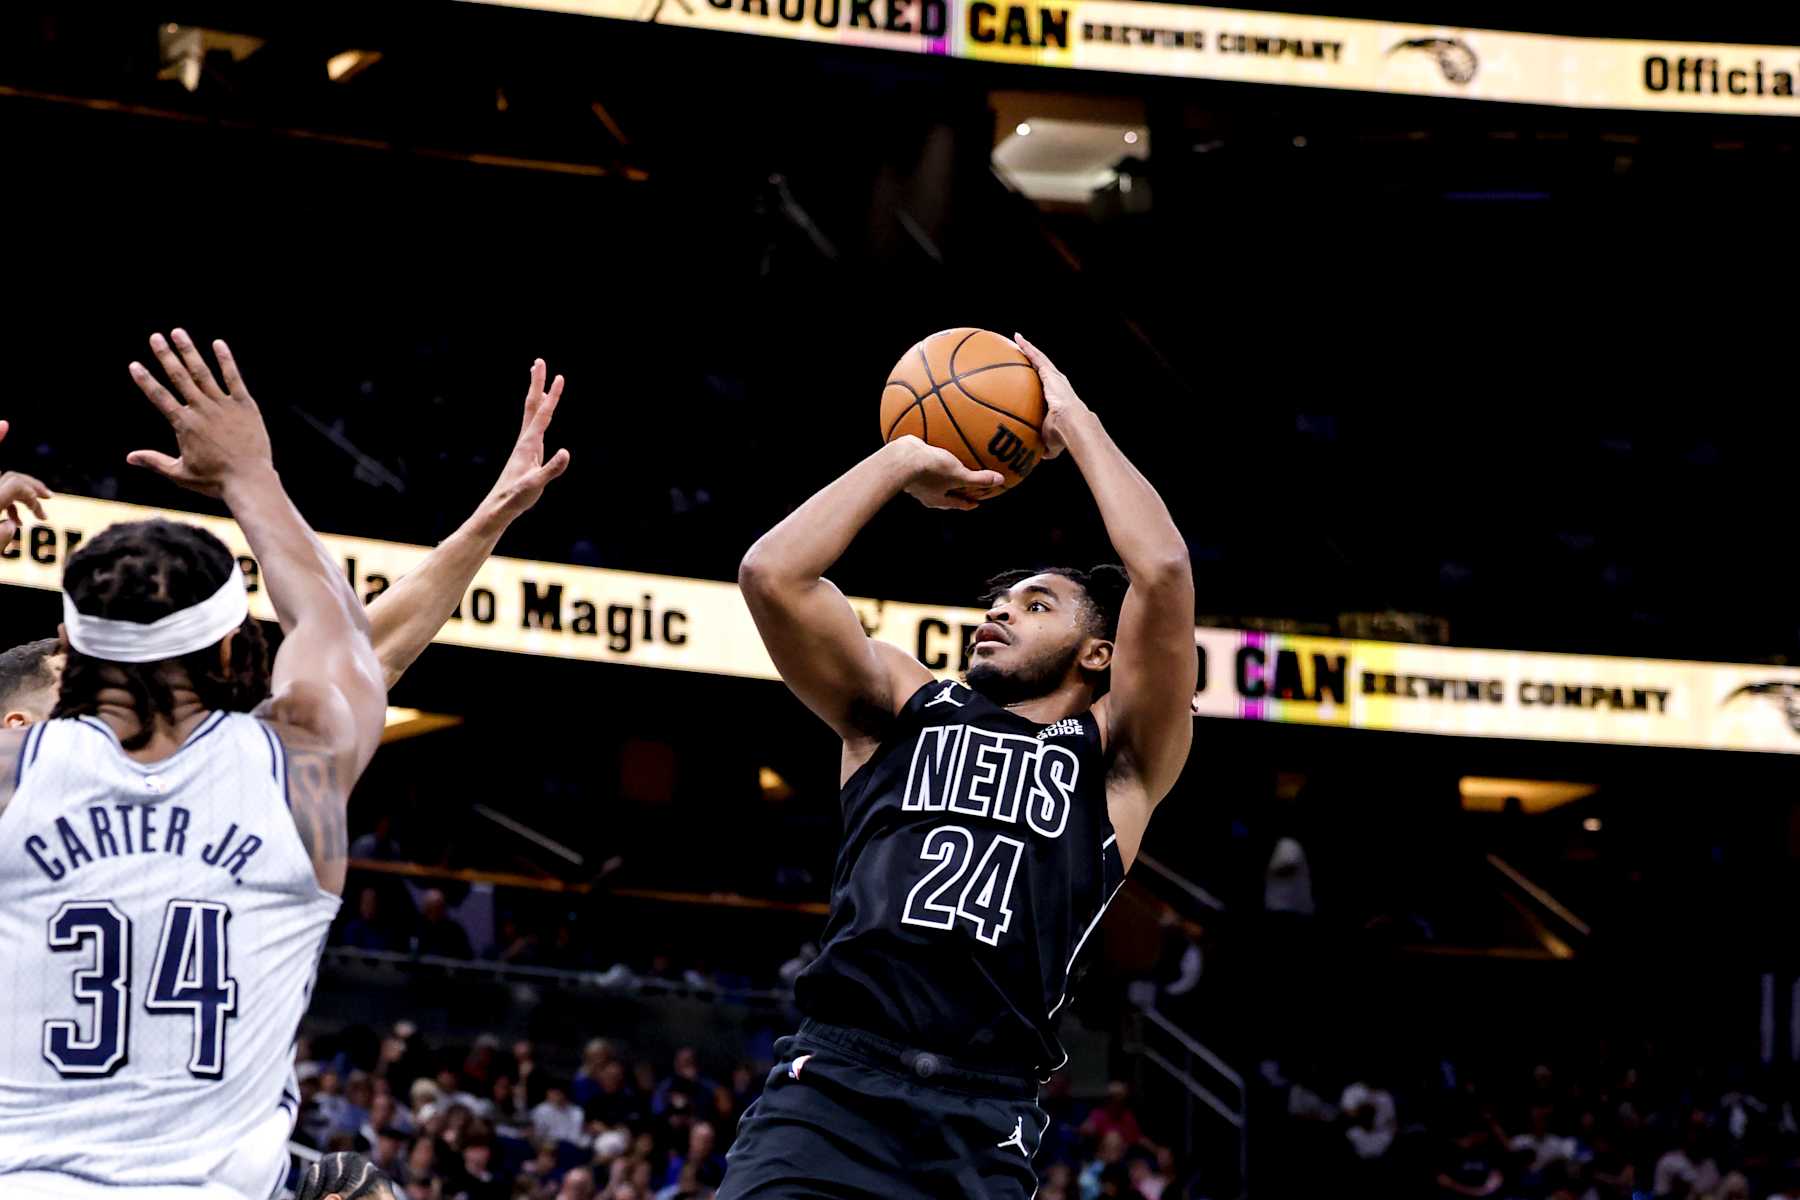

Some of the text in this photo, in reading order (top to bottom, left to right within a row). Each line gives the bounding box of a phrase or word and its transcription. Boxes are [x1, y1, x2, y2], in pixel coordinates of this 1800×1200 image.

[969, 1, 1069, 48] CAN
[1082, 22, 1205, 50] BREWING
[1217, 31, 1342, 63] COMPANY
[1644, 56, 1800, 97] Officia
[521, 581, 687, 652] Magic
[1236, 646, 1348, 704] CAN
[1361, 671, 1504, 702] BREWING
[1518, 680, 1672, 714] COMPANY
[902, 724, 1080, 838] NETS
[24, 805, 263, 885] CARTER JR.
[901, 825, 1025, 946] 24
[43, 899, 238, 1080] 34
